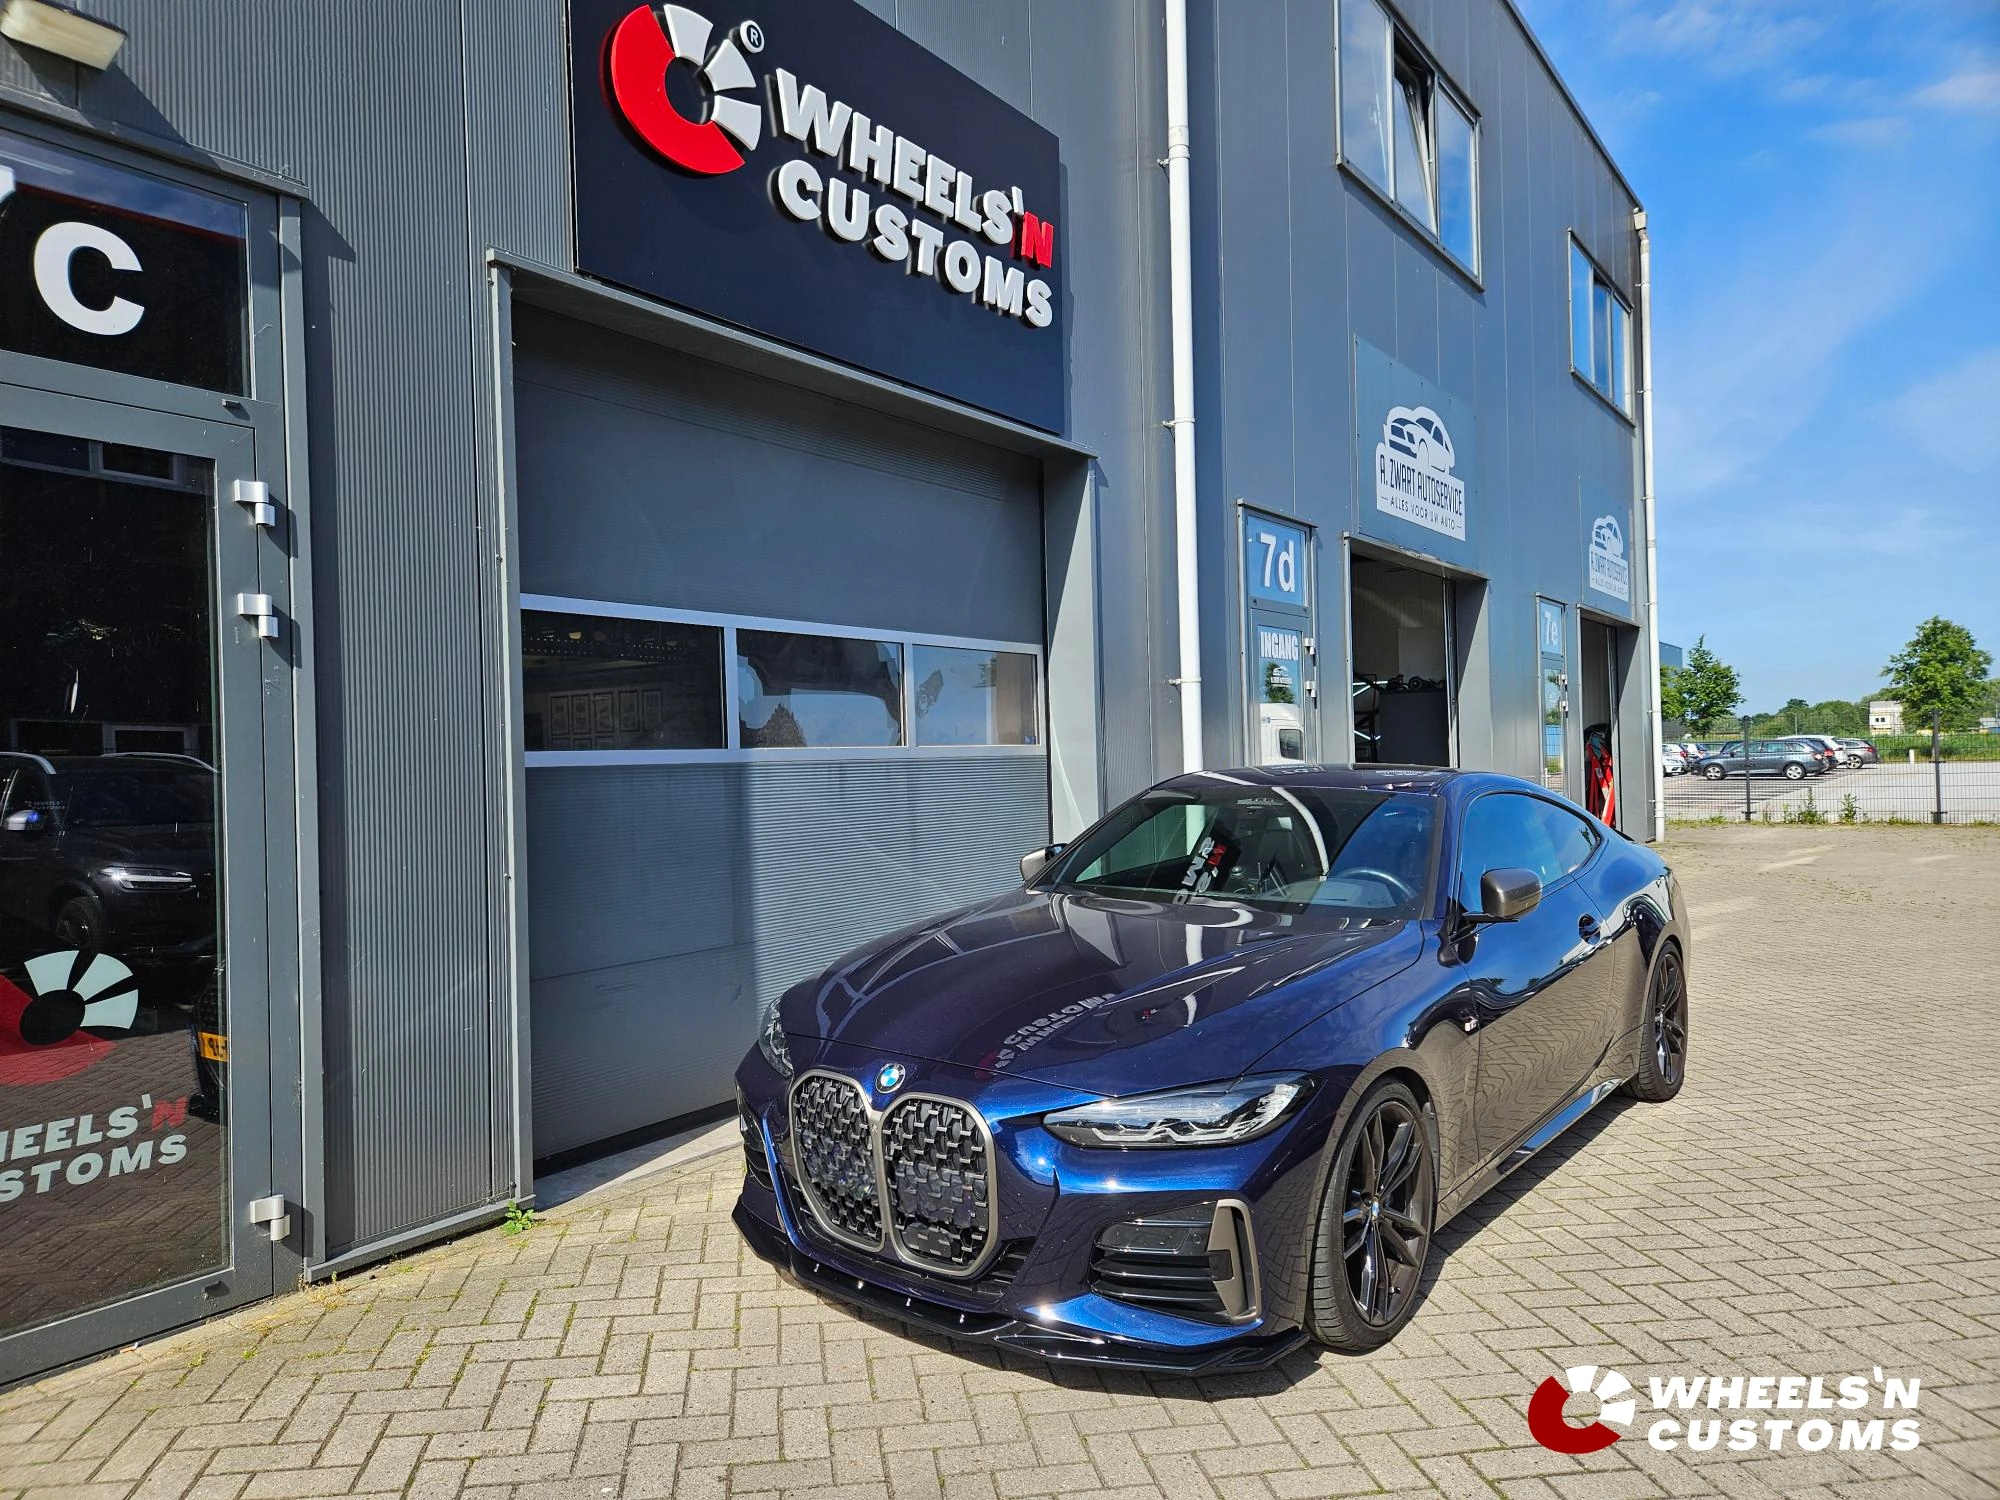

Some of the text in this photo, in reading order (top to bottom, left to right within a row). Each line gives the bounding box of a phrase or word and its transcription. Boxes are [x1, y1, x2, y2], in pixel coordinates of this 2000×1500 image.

[776, 68, 1054, 269] WHEELS'N
[778, 160, 1053, 328] CUSTOMS
[1390, 459, 1415, 497] ZWART
[1417, 471, 1463, 517] AUTOSERVICE
[1390, 496, 1409, 513] ALLES
[1411, 503, 1428, 519] VOOR
[1441, 515, 1456, 530] AUTO
[1260, 532, 1296, 593] 7d
[1260, 631, 1299, 661] INGANG
[1544, 611, 1558, 646] 7e
